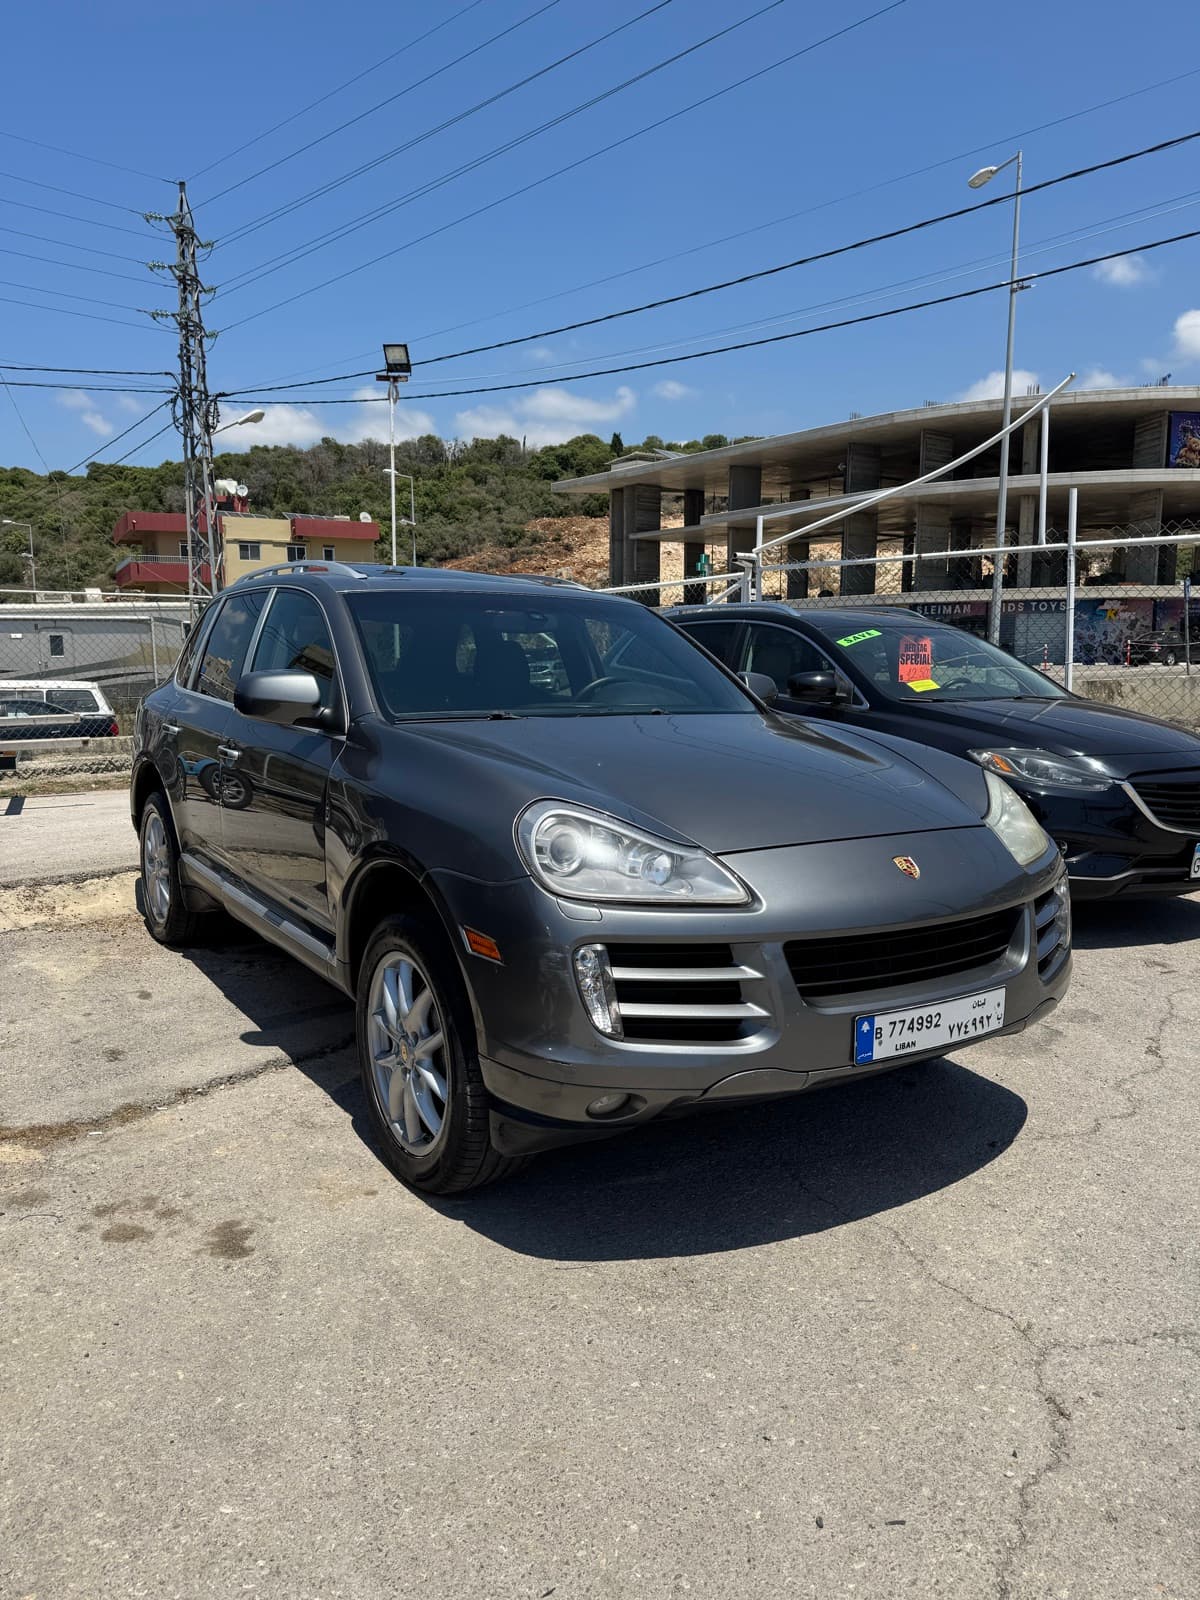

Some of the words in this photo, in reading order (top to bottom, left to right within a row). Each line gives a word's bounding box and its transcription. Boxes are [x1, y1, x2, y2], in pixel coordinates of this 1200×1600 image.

[916, 604, 971, 616] SLEIMAN
[1002, 602, 1024, 613] IDS
[1031, 601, 1066, 612] TOYS
[917, 643, 928, 653] TAG
[900, 653, 931, 665] SPECIAL
[972, 998, 987, 1009] لبنان
[875, 1026, 883, 1040] B
[889, 1012, 942, 1038] 774992
[948, 1013, 993, 1039] ٧٧٤٩٩٢
[895, 1040, 917, 1051] LIBAN
